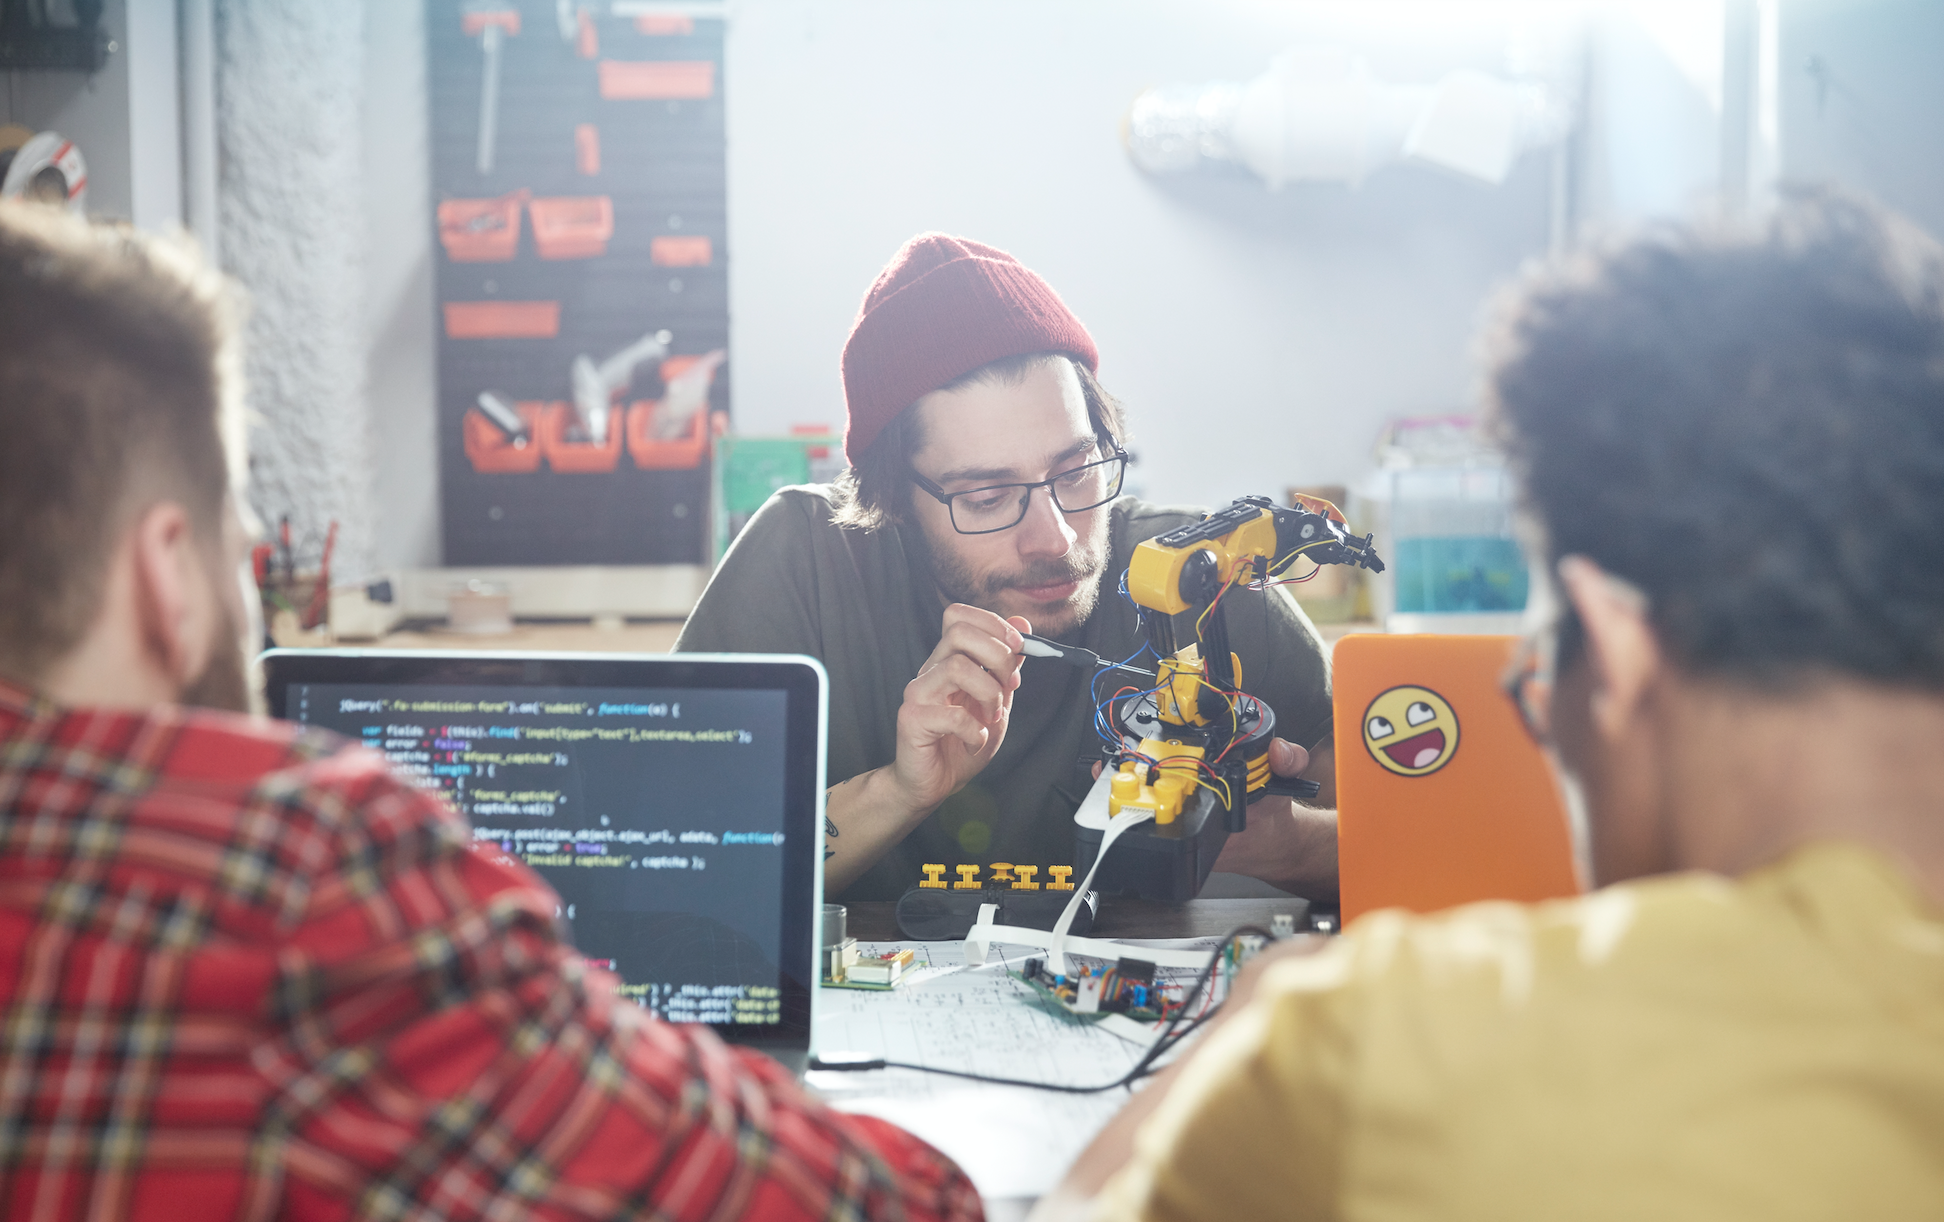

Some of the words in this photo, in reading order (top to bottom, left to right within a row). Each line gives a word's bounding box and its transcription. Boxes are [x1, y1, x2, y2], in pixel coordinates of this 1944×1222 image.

[362, 725, 382, 737] var
[386, 724, 425, 738] fields
[385, 739, 418, 750] error
[434, 738, 472, 751] false;
[473, 802, 555, 817] captcha.val()
[526, 842, 560, 853] error
[575, 842, 608, 856] true;
[641, 855, 690, 869] captcha
